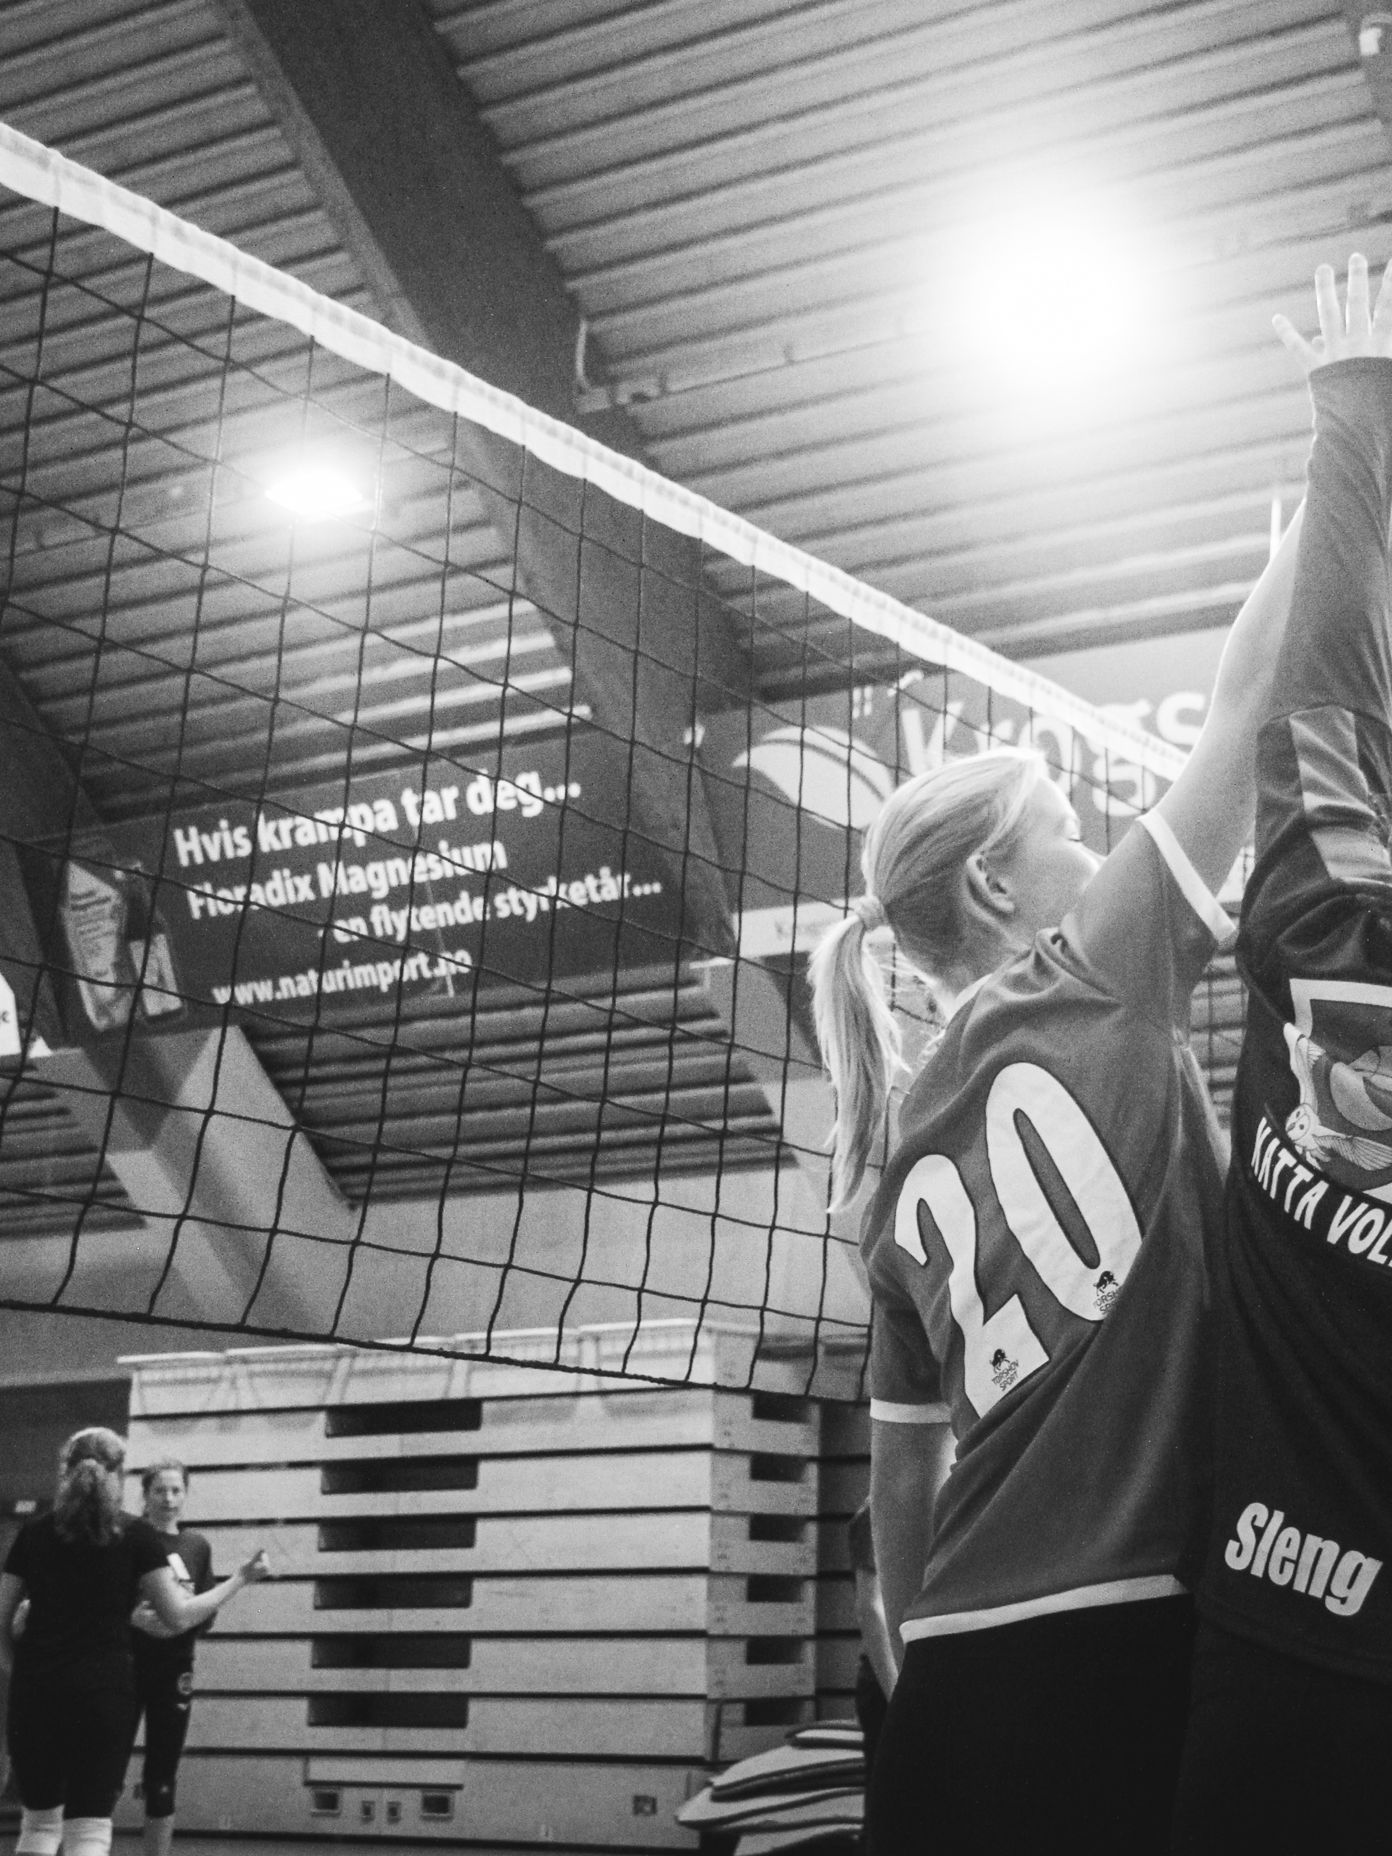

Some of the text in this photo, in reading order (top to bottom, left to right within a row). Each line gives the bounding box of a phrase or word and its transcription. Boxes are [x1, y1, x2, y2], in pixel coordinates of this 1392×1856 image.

[173, 818, 253, 868] Hvis
[257, 798, 399, 854] krampa
[401, 786, 459, 827] tar
[187, 839, 508, 920] Floradix Magnesium
[333, 916, 369, 943] en
[369, 890, 491, 942] flytende
[211, 949, 472, 1005] www.naturimport.no
[894, 1061, 1143, 1420] 20
[1225, 1502, 1383, 1616] Sleng
